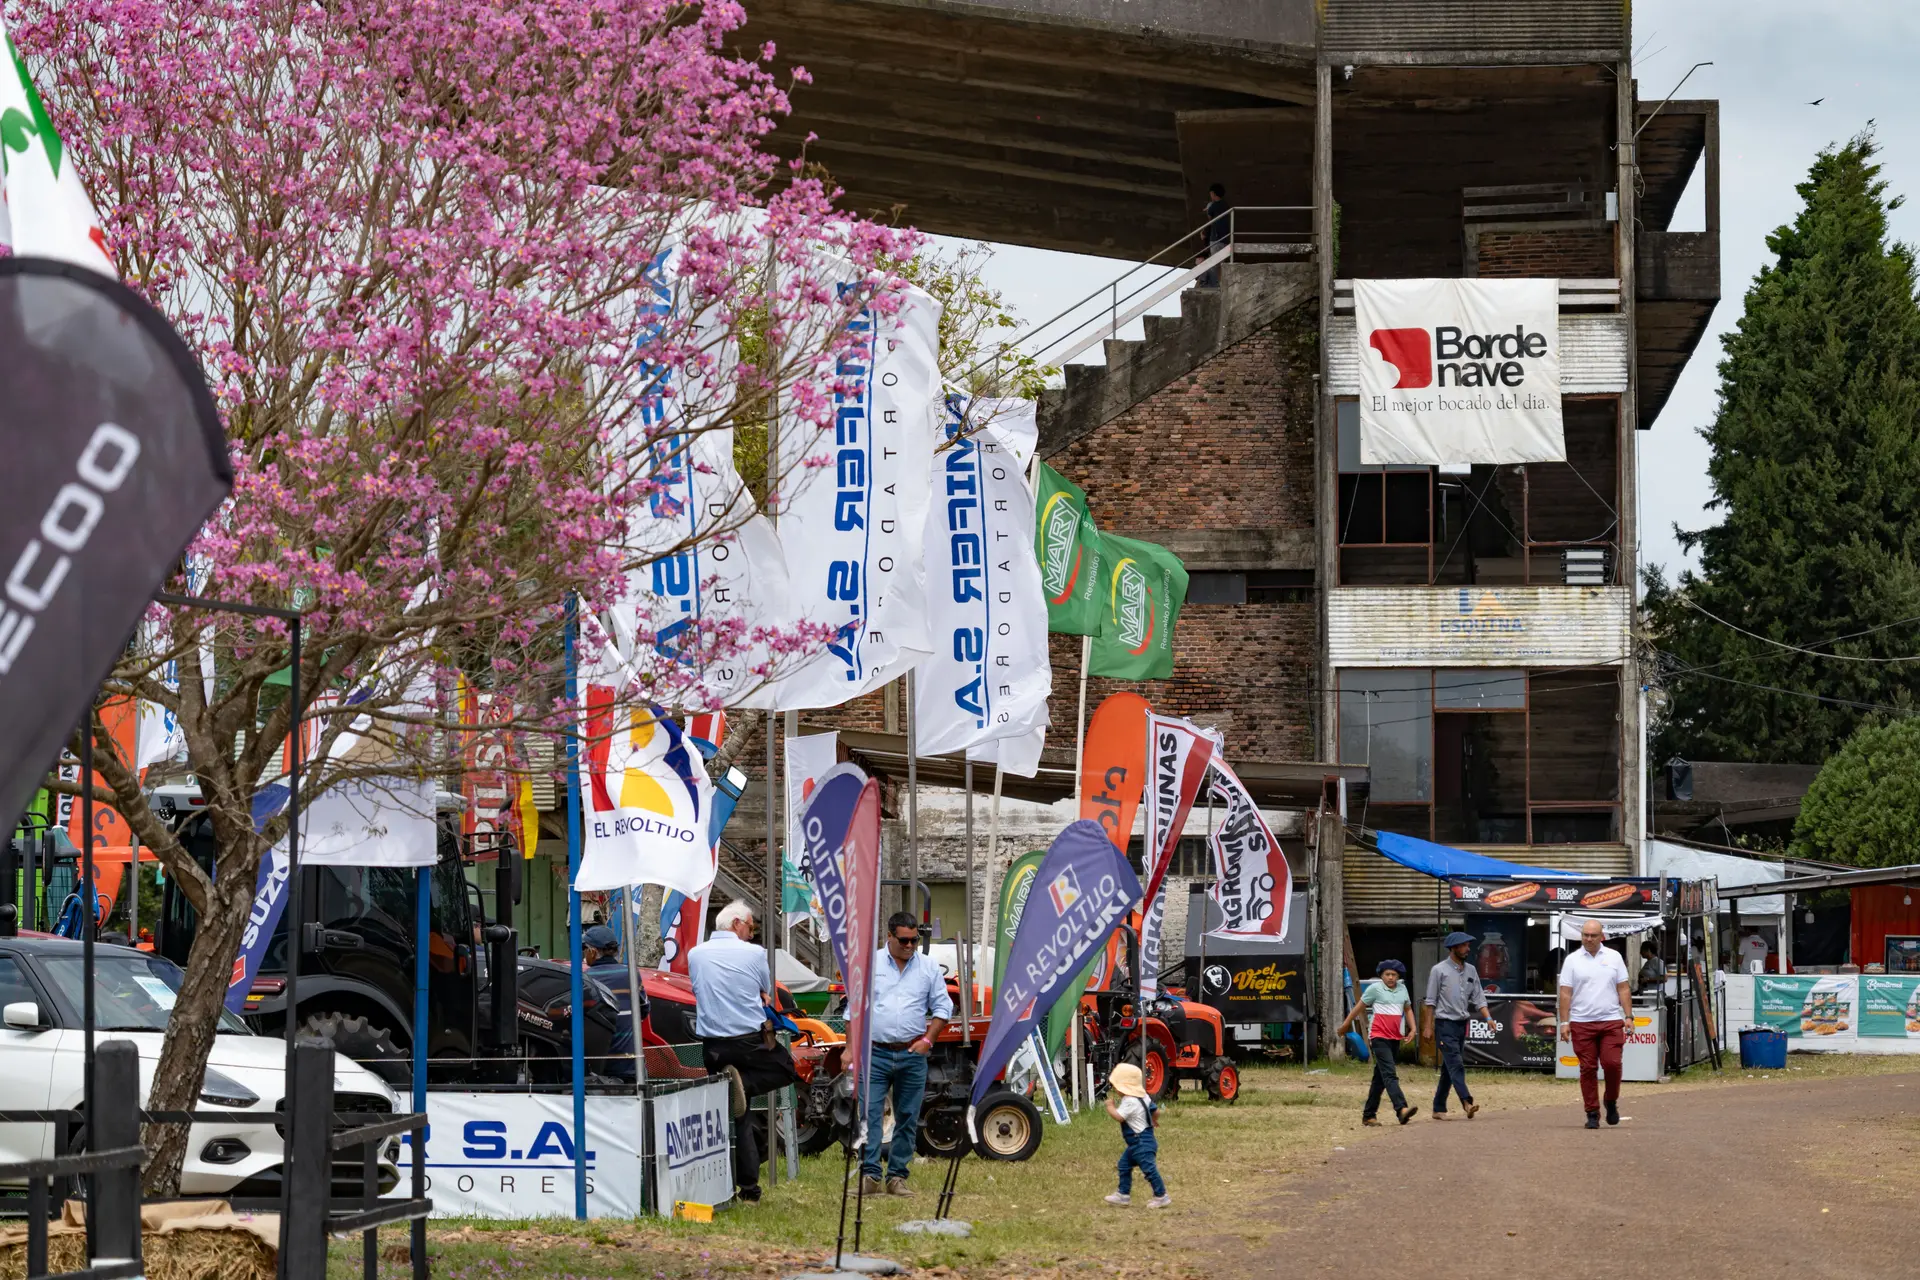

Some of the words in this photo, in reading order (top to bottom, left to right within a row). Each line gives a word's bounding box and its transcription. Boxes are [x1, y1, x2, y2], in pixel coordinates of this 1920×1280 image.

[1435, 325, 1547, 360] Borde
[1438, 361, 1524, 387] nave
[1372, 395, 1387, 412] El
[1392, 397, 1433, 415] mejor
[1438, 395, 1492, 411] bocado
[1496, 393, 1518, 410] del
[1523, 393, 1549, 411] dia.
[1044, 495, 1081, 596] MARY
[1084, 556, 1100, 601] Respaldo
[1162, 568, 1172, 611] Asegurado
[1119, 562, 1145, 648] MARY
[1160, 611, 1170, 651] Respaldo
[1440, 619, 1526, 633] ESQUINA
[1157, 732, 1178, 848] QUINAS
[594, 821, 610, 838] EL
[615, 817, 695, 842] REVOLTIJO
[1462, 886, 1484, 894] Borde
[1003, 981, 1028, 1012] EL
[1026, 874, 1115, 985] REVOLTIJO
[1233, 969, 1297, 994] Viejito
[1262, 963, 1276, 976] el
[1470, 1030, 1495, 1039] nave
[1623, 1032, 1656, 1044] PANCHO
[463, 1120, 596, 1160] S.A.
[705, 1108, 726, 1148] S.A.
